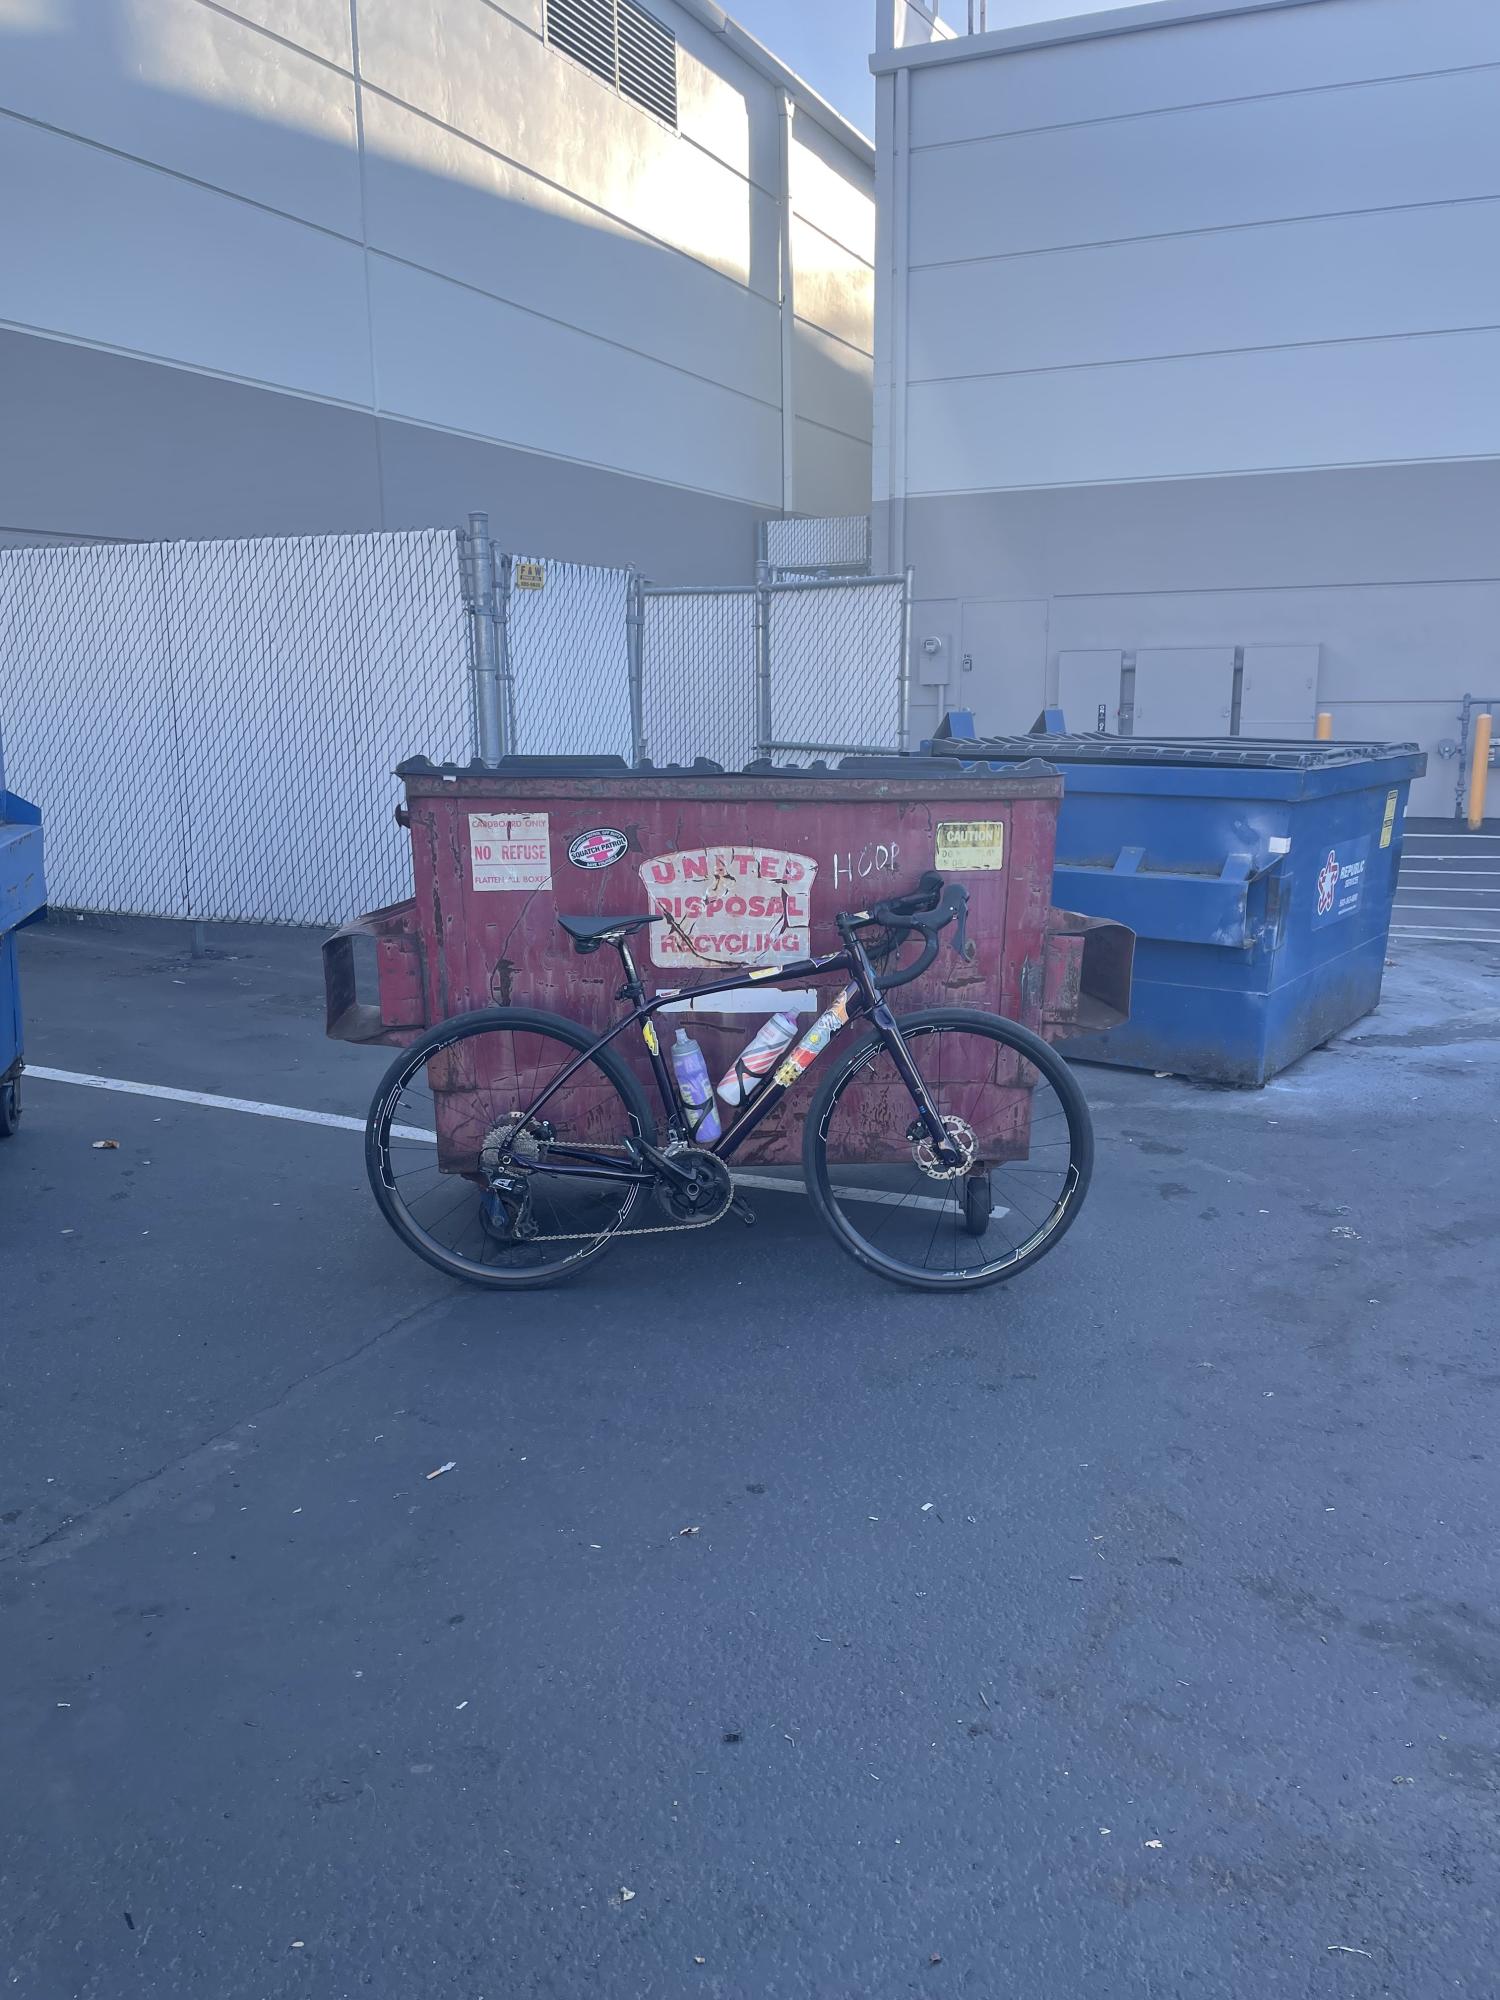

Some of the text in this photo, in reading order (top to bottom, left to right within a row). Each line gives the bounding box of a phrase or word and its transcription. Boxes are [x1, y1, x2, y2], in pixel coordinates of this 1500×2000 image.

[520, 566, 526, 574] F
[534, 566, 542, 576] W
[525, 820, 546, 828] ONLY
[946, 831, 993, 842] CAUTION
[474, 844, 547, 861] NO REFUSE
[571, 838, 626, 859] SQUATCH PATROL
[651, 854, 806, 885] UNITED
[655, 895, 804, 919] DISPOSAL
